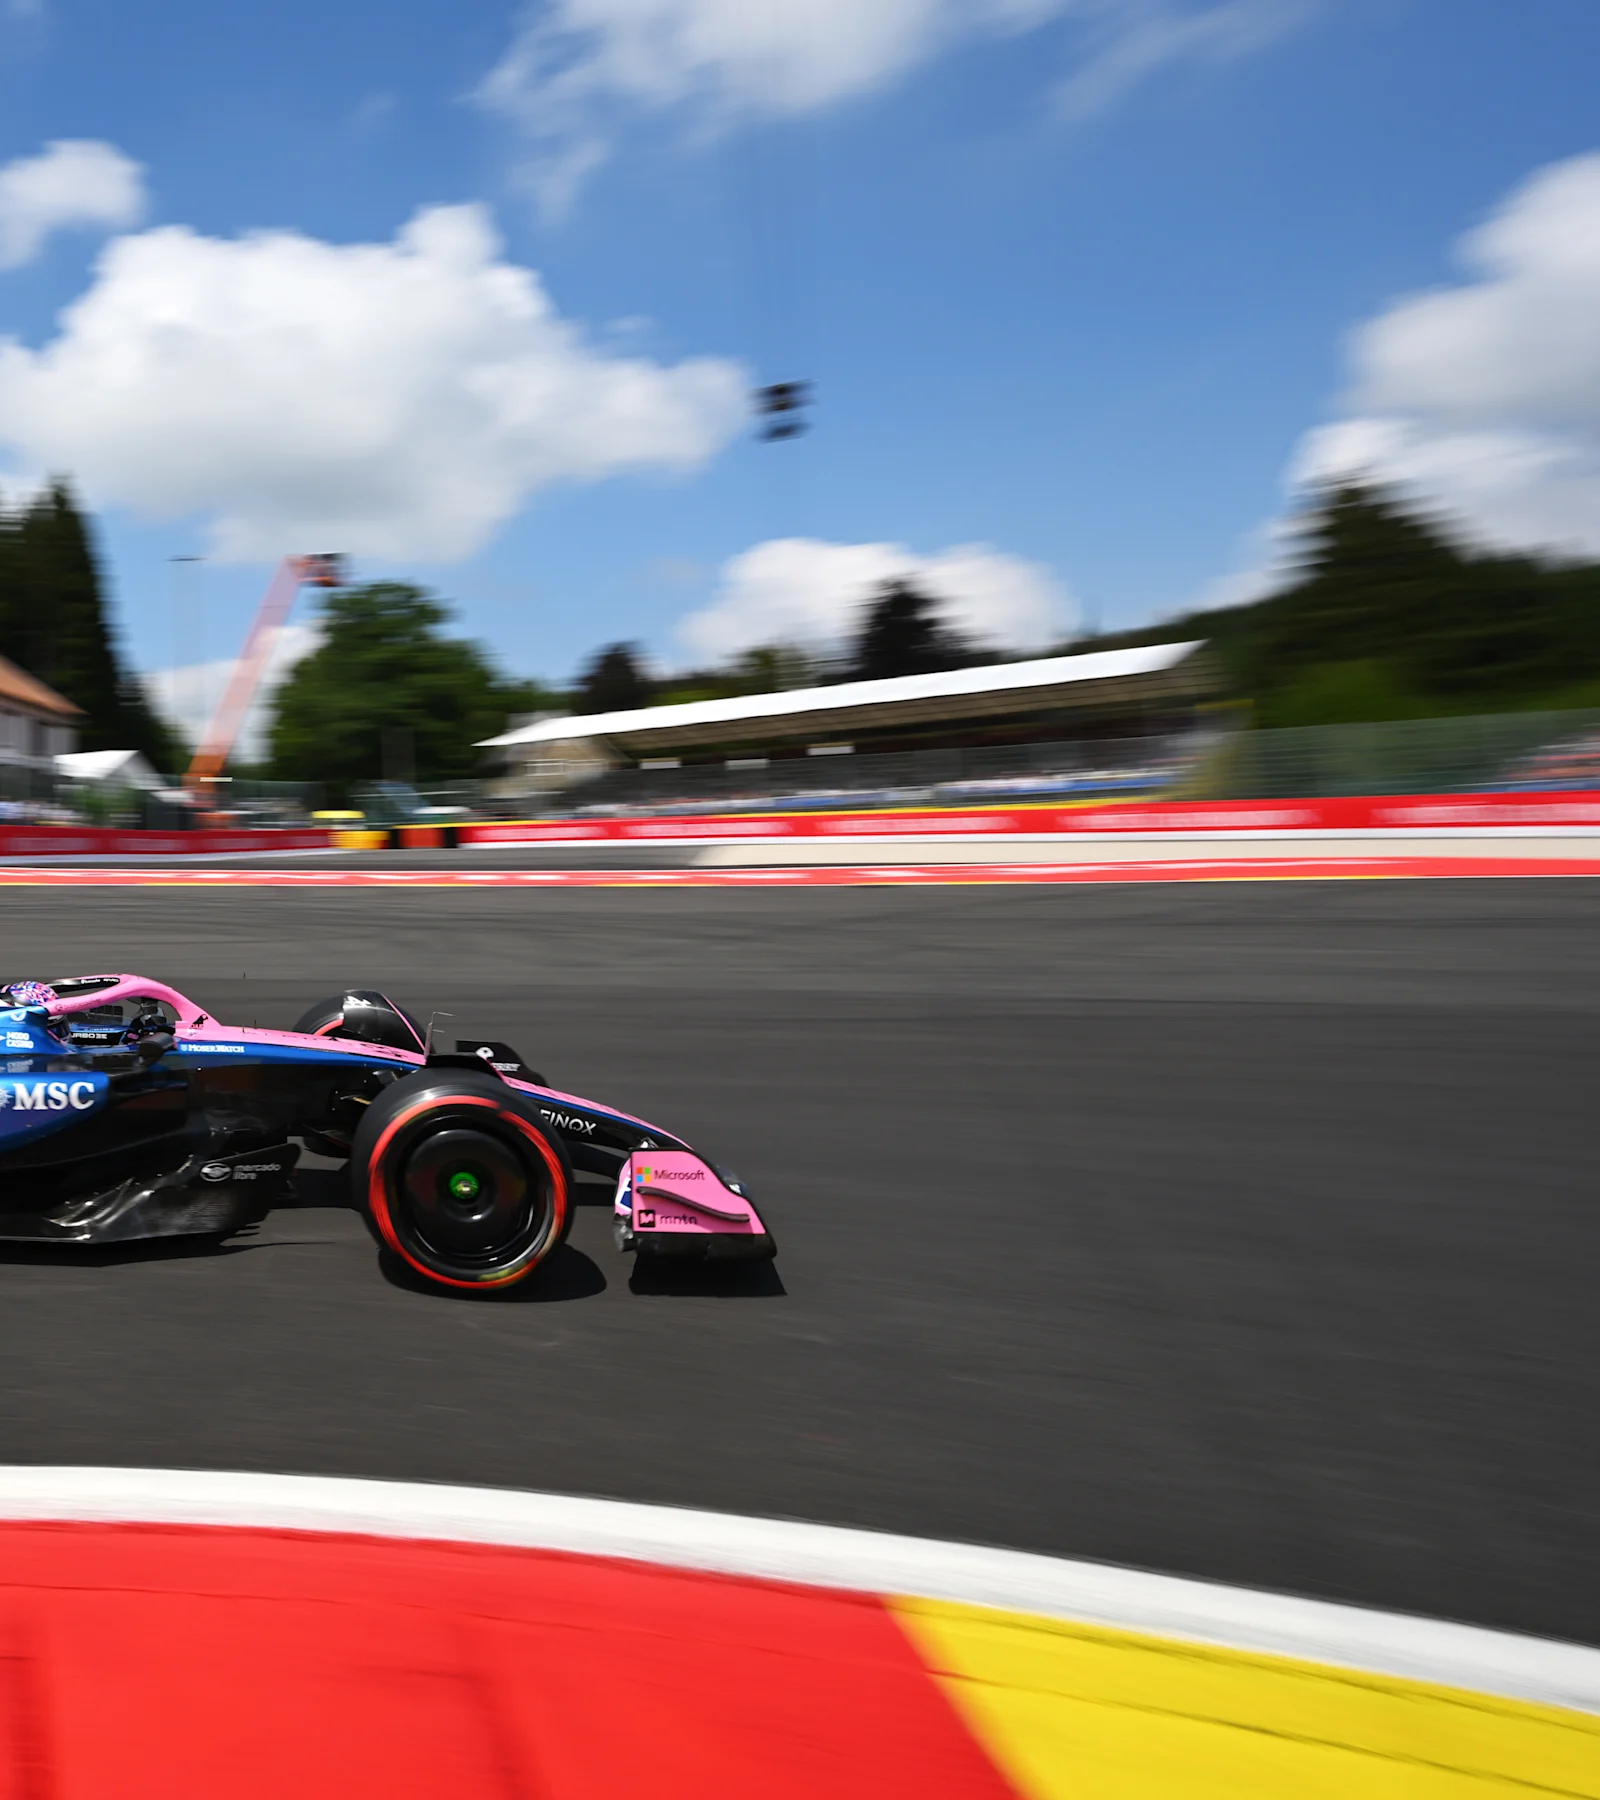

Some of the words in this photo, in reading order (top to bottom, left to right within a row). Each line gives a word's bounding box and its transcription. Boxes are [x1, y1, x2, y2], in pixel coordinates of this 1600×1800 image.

[12, 1081, 96, 1110] MSC
[233, 1163, 281, 1172] mercado
[233, 1172, 258, 1180] libre
[654, 1170, 705, 1180] Microsoft
